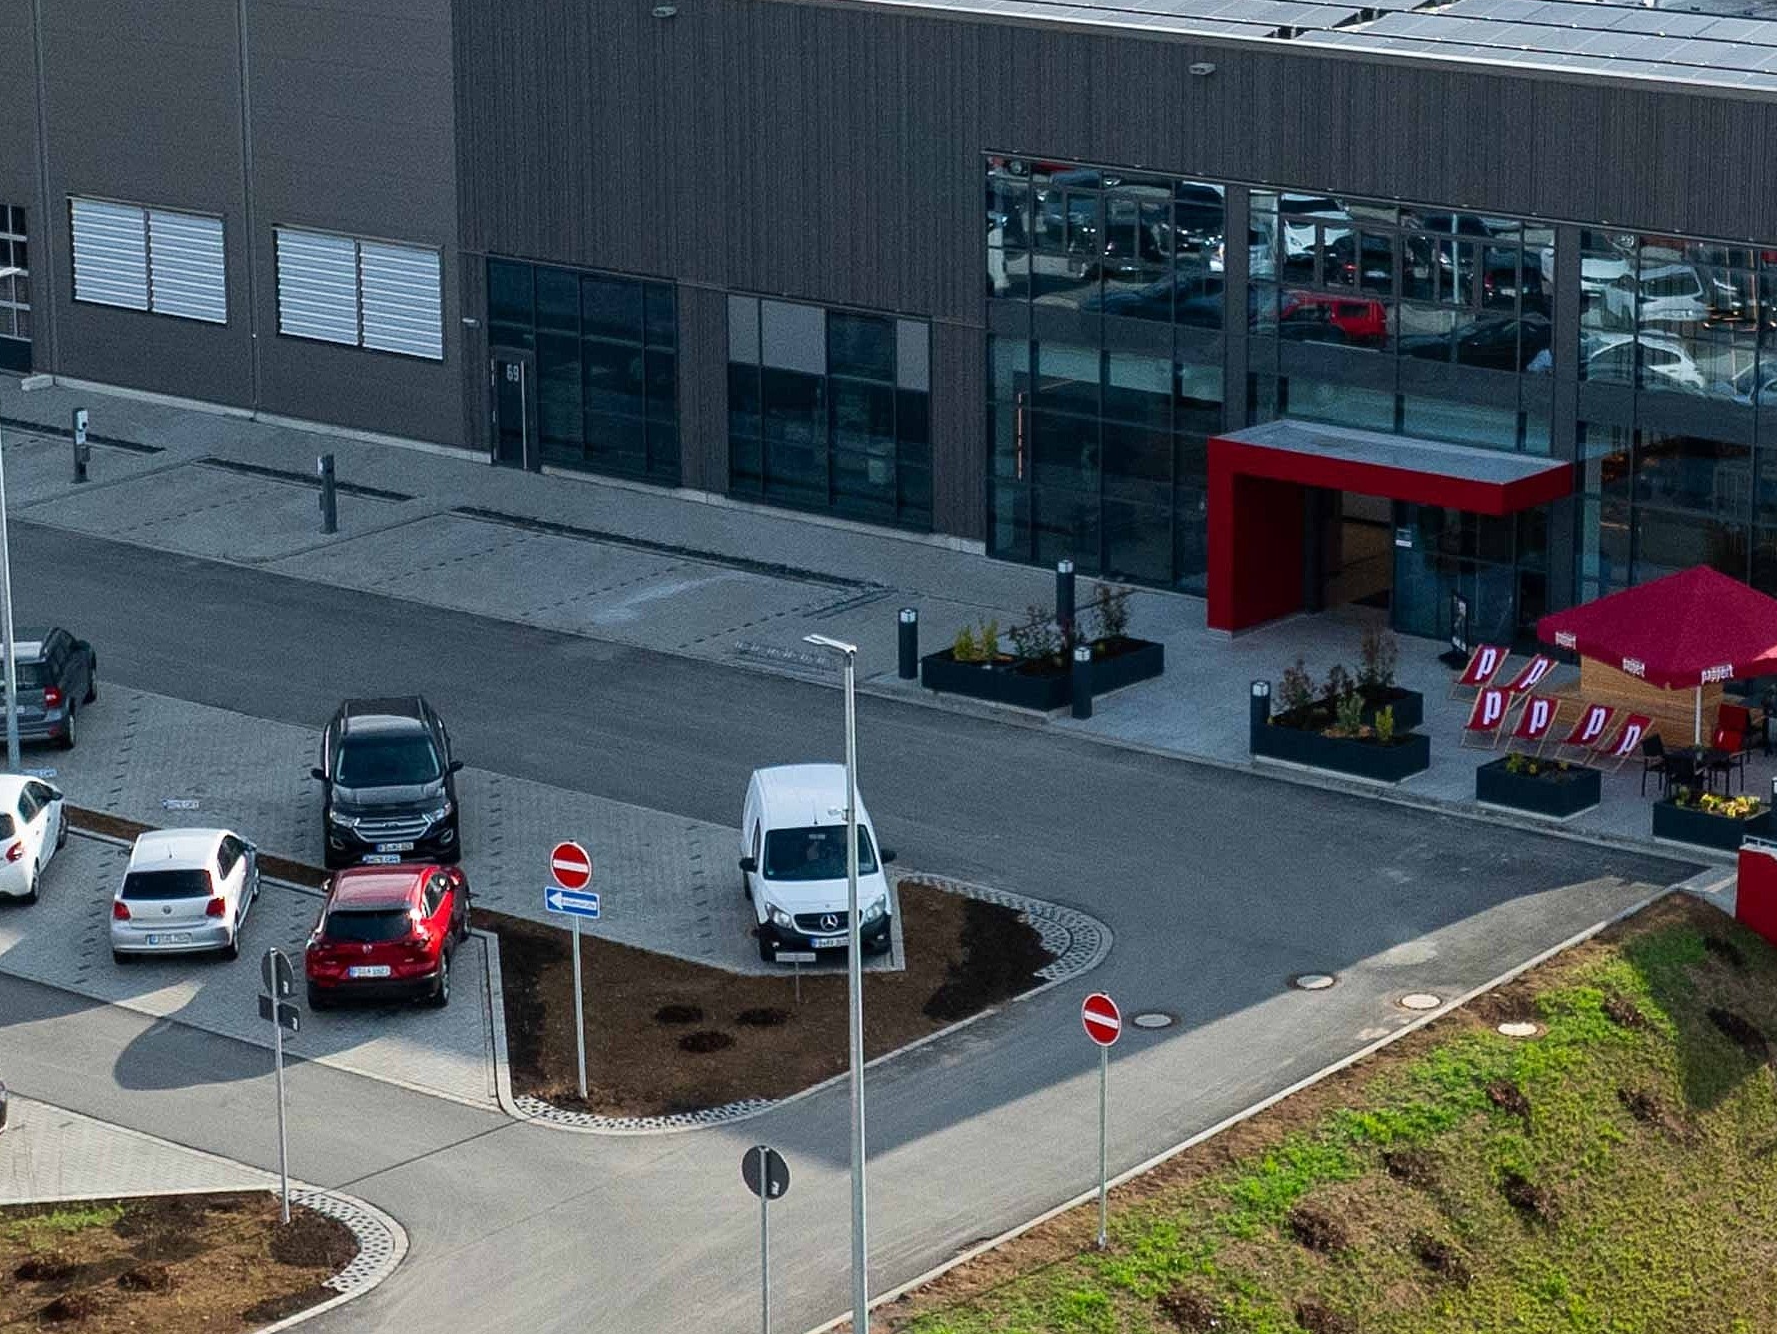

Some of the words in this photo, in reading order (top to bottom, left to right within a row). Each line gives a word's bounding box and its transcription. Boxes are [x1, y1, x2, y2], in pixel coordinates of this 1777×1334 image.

[506, 364, 519, 382] 69
[1474, 648, 1497, 680] p
[1519, 658, 1549, 689] p
[1483, 690, 1502, 725] p
[1529, 699, 1549, 734] p
[1582, 707, 1606, 740] p
[1615, 724, 1641, 756] p
